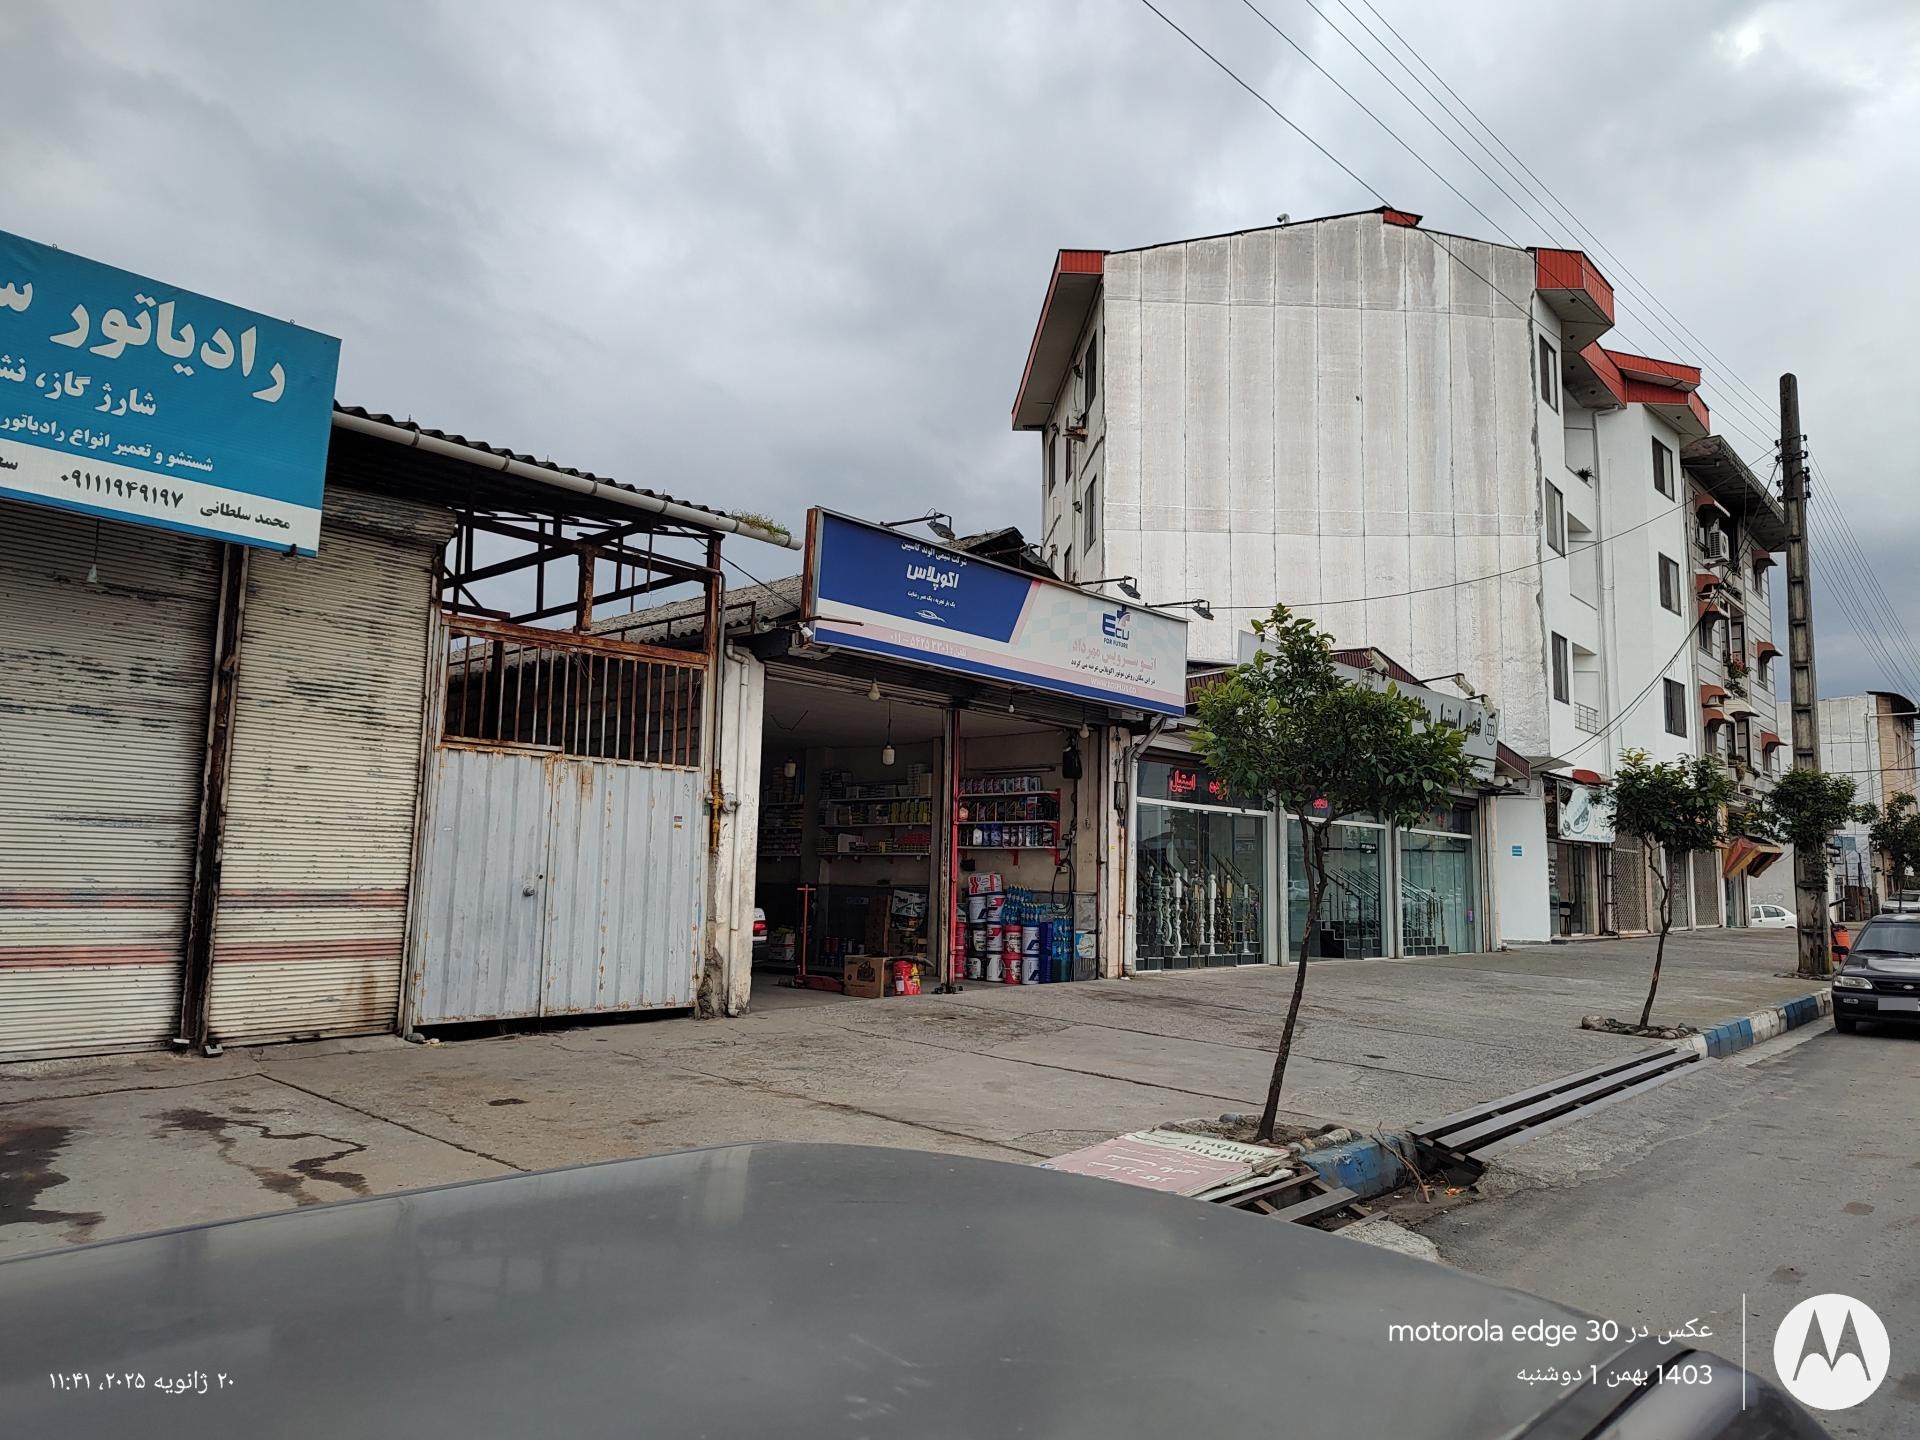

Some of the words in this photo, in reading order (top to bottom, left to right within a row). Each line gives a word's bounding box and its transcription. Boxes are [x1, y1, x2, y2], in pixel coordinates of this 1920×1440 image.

[50, 293, 286, 402] رادیاتور
[0, 354, 27, 382] نش
[95, 382, 156, 416] شارژ
[0, 413, 65, 442] رادیاتور
[69, 428, 110, 450] انواع
[112, 442, 152, 457] تعمیر
[153, 452, 163, 465] و
[166, 451, 214, 472] شستشو
[61, 468, 184, 509] ۰۹۱۱۱۹۴۹۱۹۷
[200, 500, 252, 521] سلطانی
[254, 513, 291, 530] محمد
[906, 563, 960, 591] اکوپلاس
[1168, 768, 1197, 793] استیل
